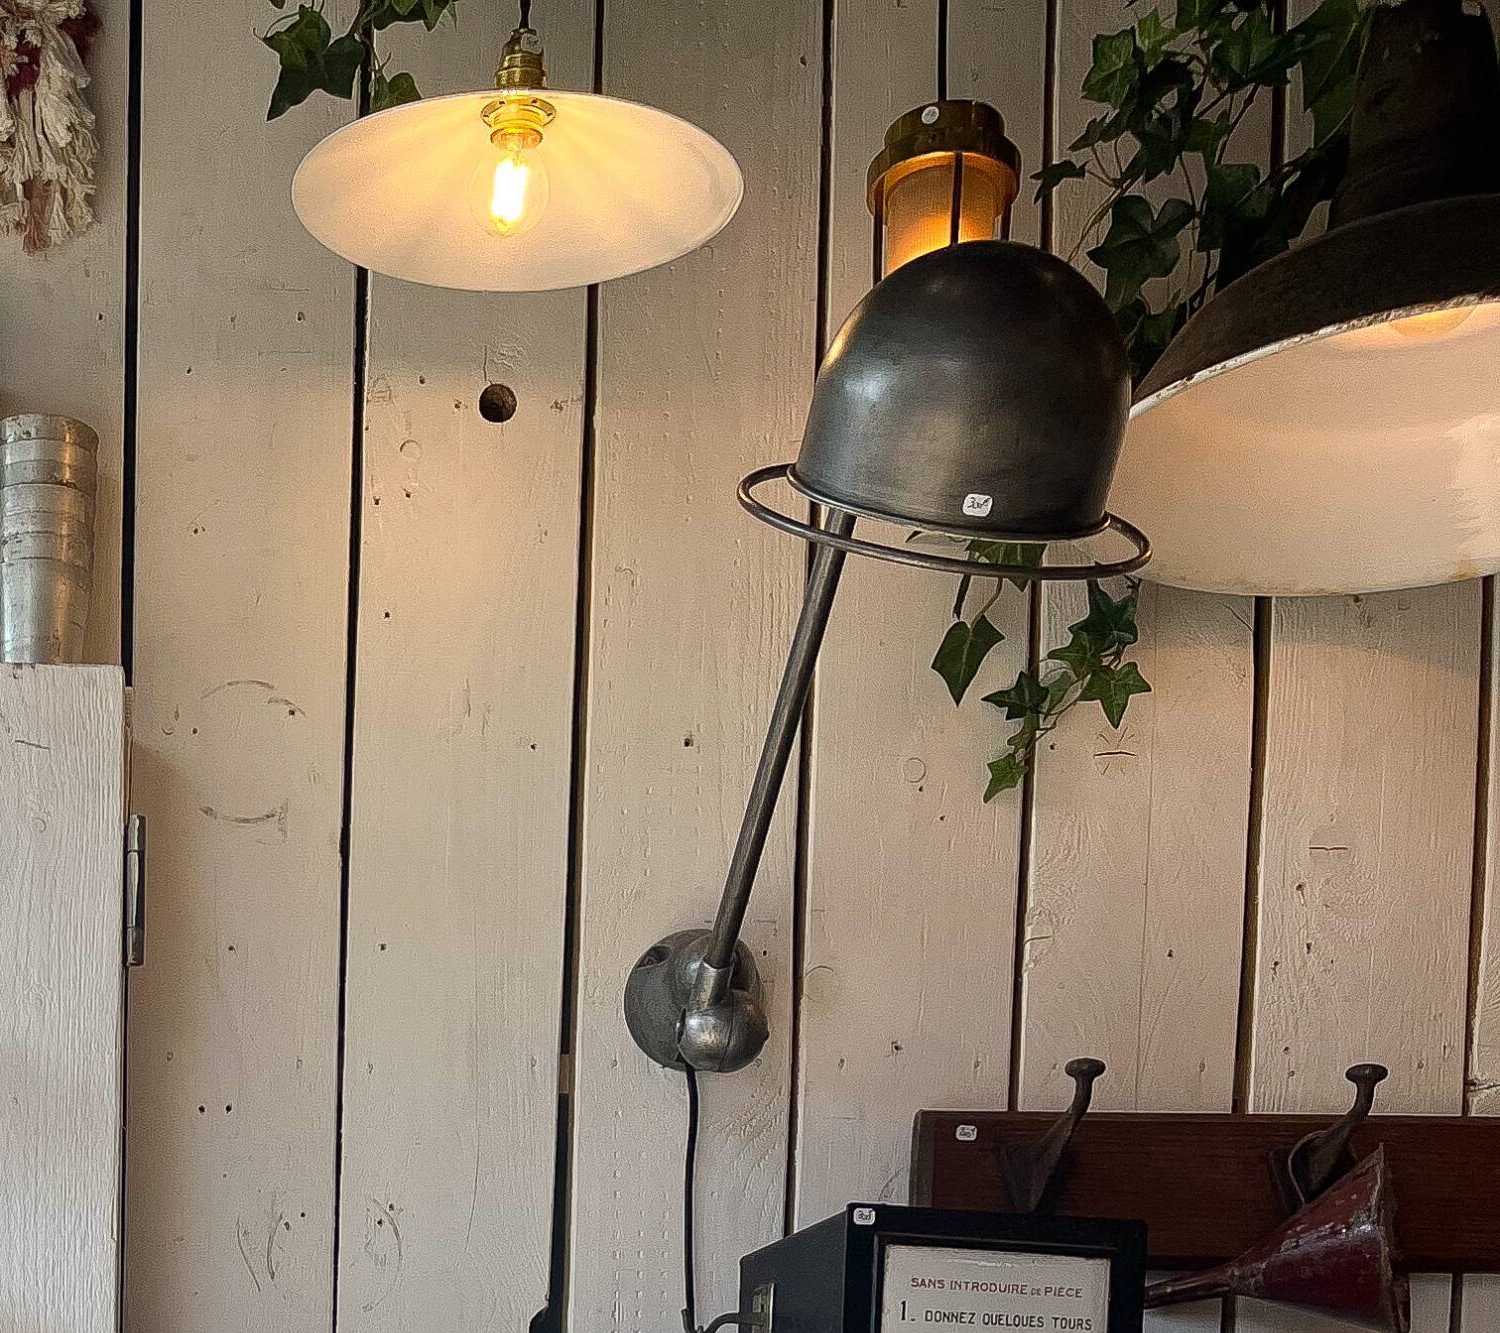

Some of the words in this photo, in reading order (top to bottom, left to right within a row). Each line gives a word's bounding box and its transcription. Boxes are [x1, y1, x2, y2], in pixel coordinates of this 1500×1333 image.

[911, 1277, 946, 1290] SANS
[950, 1280, 1029, 1296] INTRODUIRE
[924, 1310, 977, 1325] DONNEZ
[982, 1313, 1045, 1329] QUELQUES
[1052, 1317, 1093, 1331] TOURS
